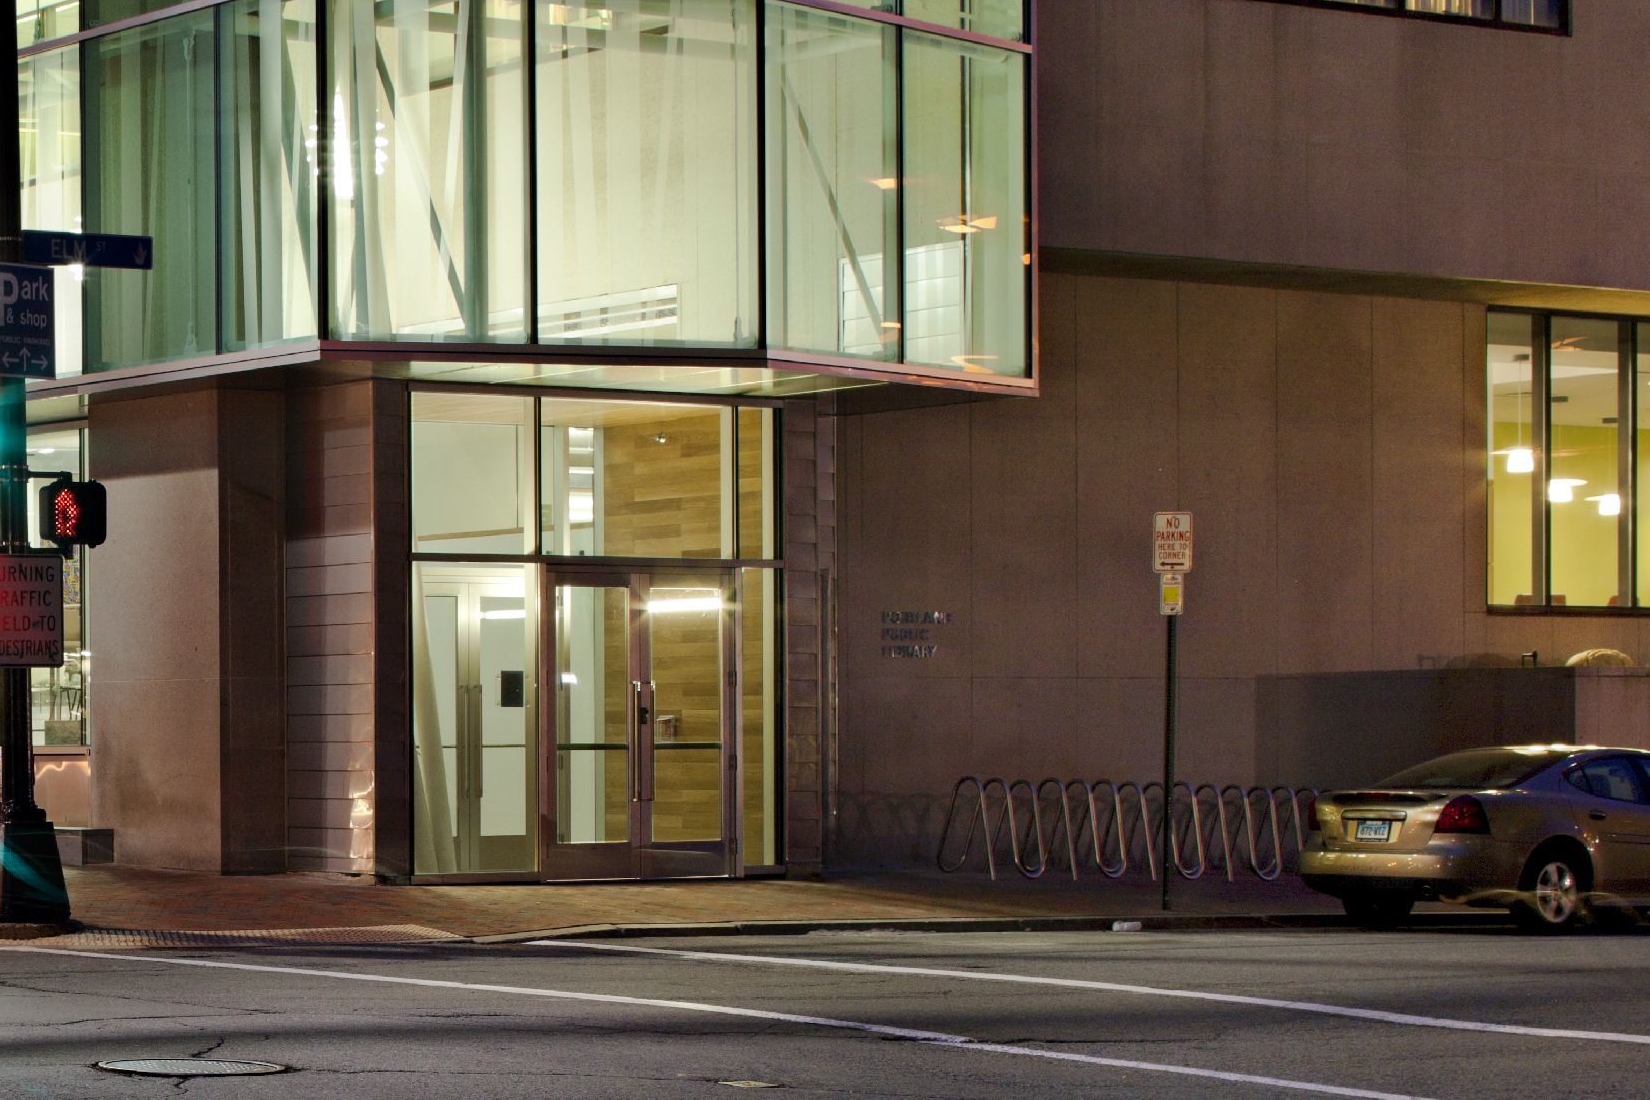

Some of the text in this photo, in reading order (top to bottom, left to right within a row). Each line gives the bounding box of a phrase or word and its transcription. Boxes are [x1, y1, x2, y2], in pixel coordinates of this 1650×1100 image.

[50, 238, 107, 261] ELM ST
[6, 307, 48, 330] & shop
[1166, 517, 1180, 529] NO
[1156, 531, 1190, 542] PARKING
[1158, 543, 1188, 551] HERE TO
[1158, 551, 1186, 560] CORNER
[38, 615, 56, 632] TO
